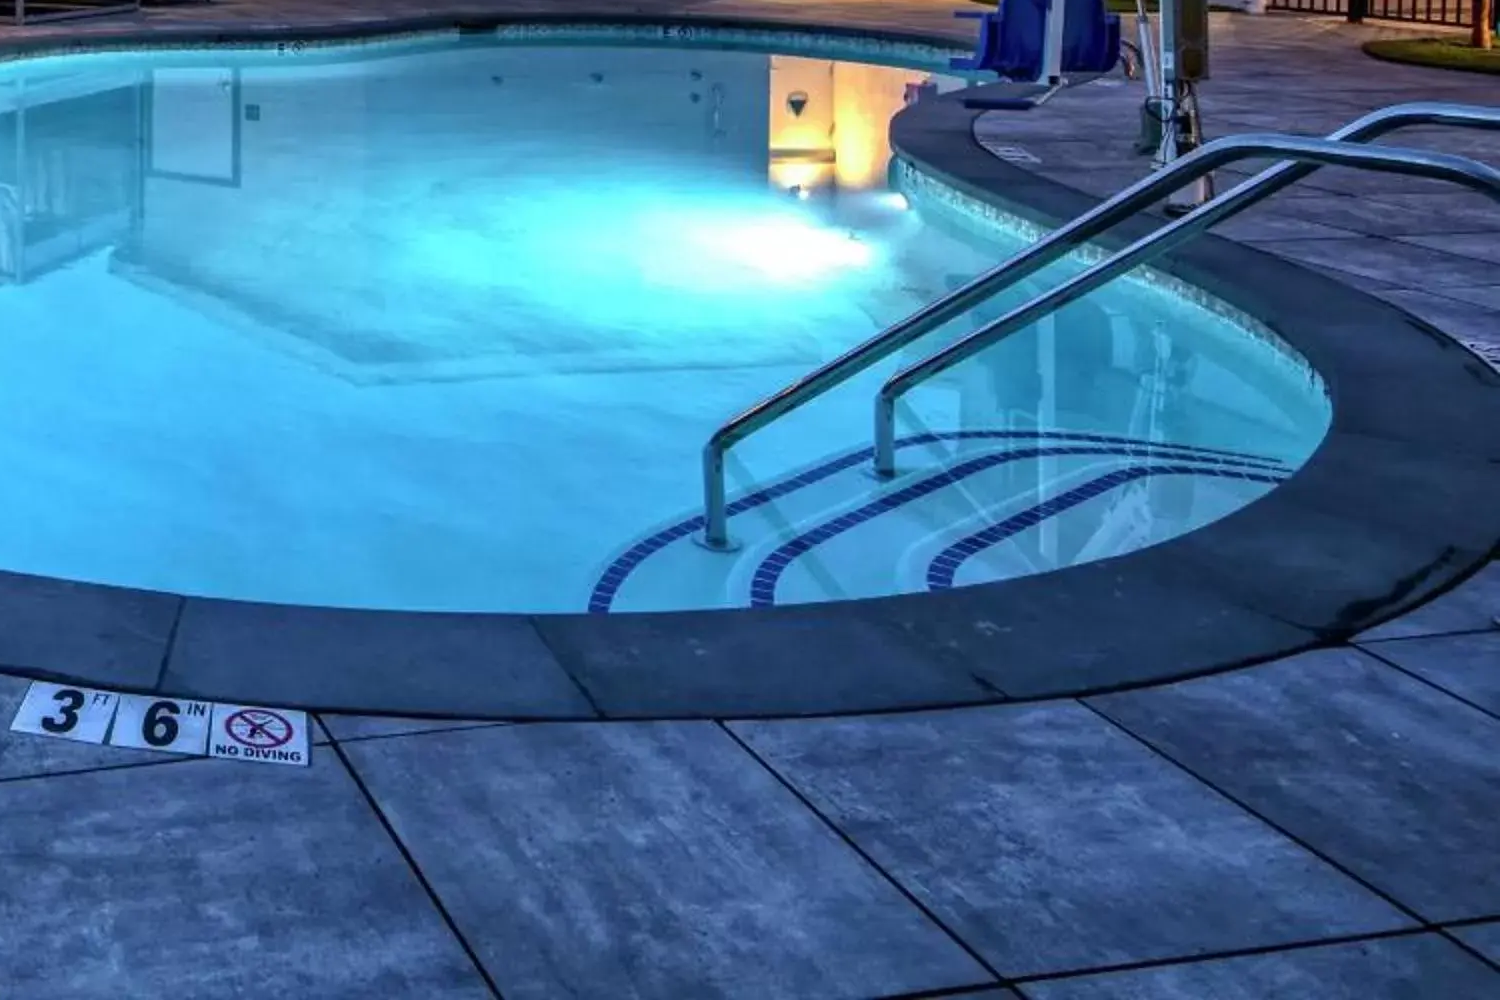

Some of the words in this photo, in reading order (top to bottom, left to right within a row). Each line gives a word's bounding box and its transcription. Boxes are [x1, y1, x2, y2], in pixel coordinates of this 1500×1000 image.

[41, 689, 85, 733] 3
[92, 693, 112, 707] FT
[142, 700, 181, 747] 6
[187, 703, 206, 717] IN
[215, 744, 240, 757] NO
[243, 748, 302, 762] DIVING
